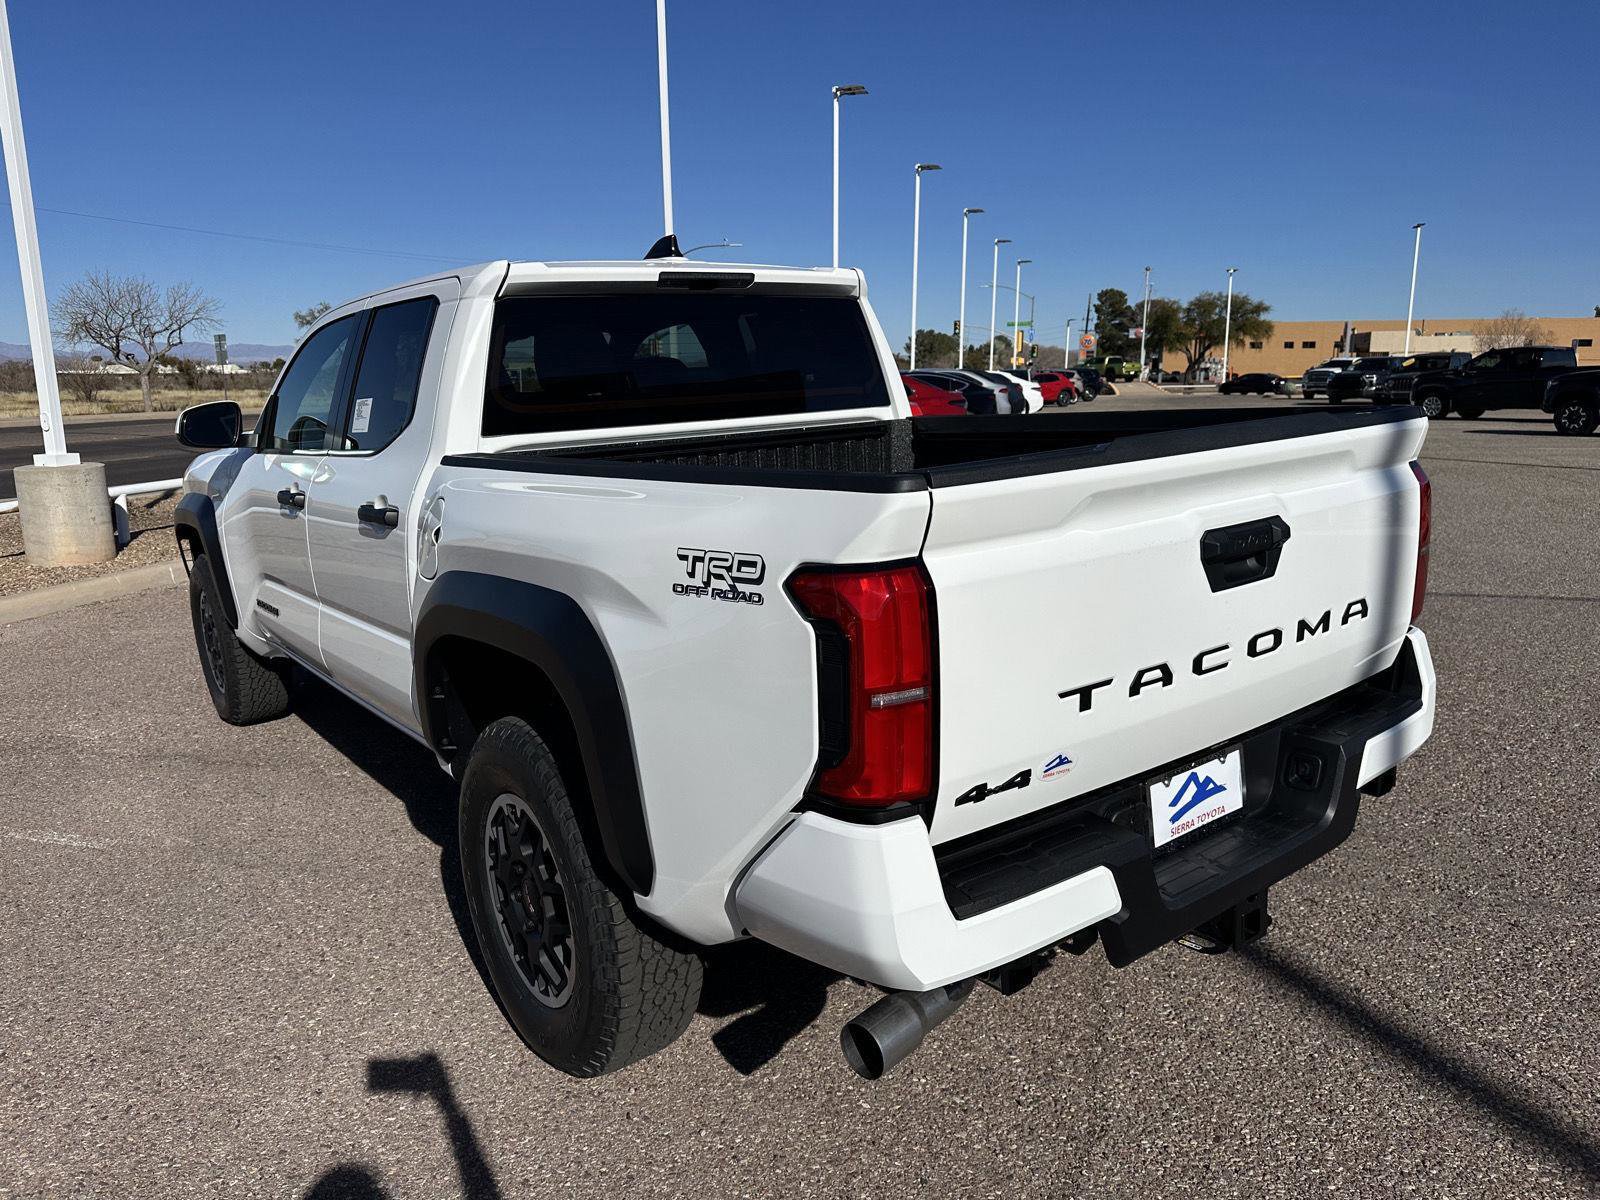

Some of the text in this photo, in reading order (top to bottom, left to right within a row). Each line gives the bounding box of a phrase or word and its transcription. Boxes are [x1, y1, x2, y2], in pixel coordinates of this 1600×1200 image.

[677, 547, 766, 587] TRD
[672, 583, 764, 605] OFF ROAD
[1057, 598, 1369, 713] TACOMA
[1170, 805, 1226, 837] SIERRA TOYOTA
